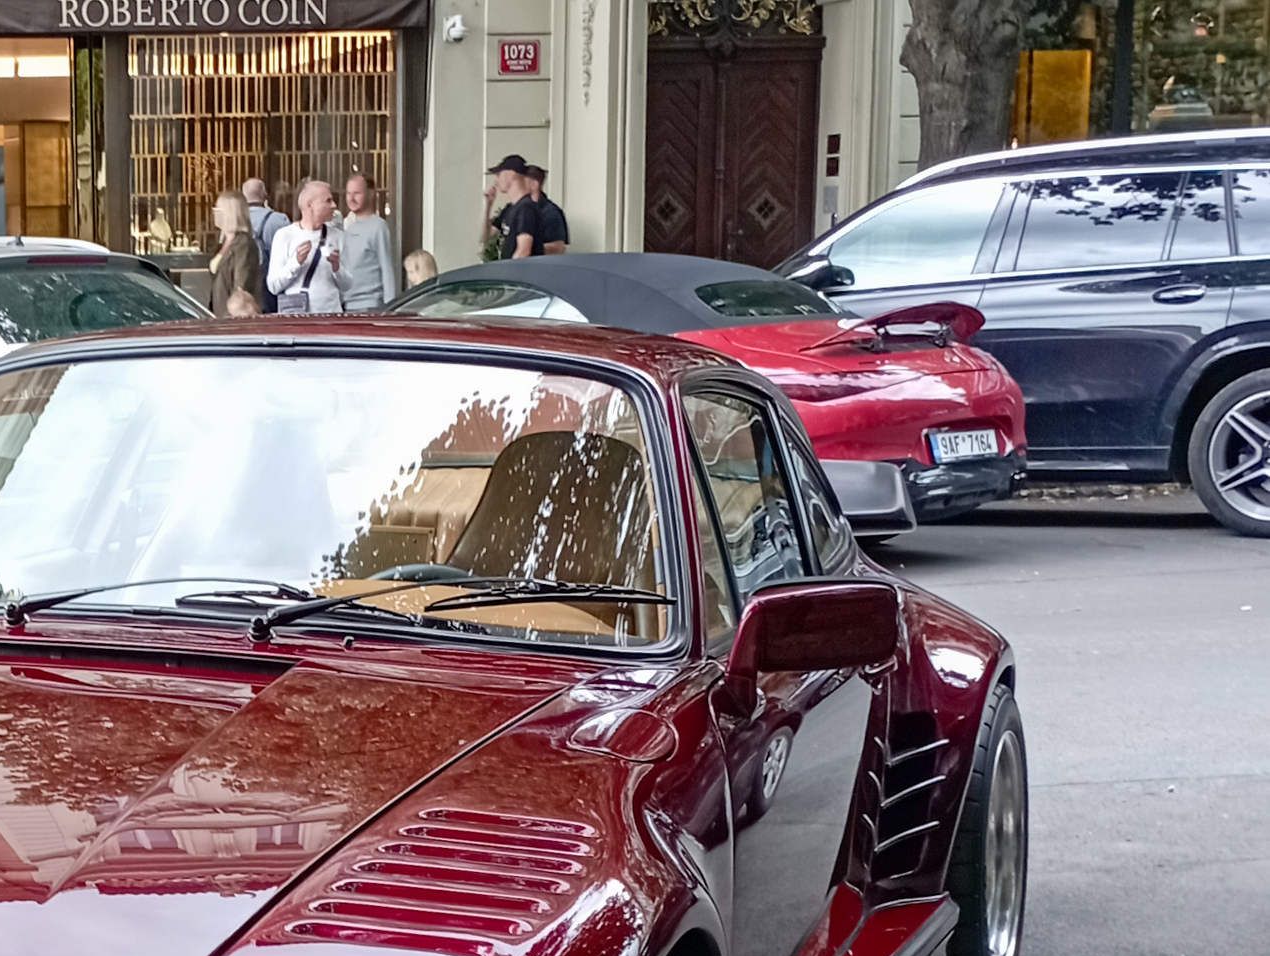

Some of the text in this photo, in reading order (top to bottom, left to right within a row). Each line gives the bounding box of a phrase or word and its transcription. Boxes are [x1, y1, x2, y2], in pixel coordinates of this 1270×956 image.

[59, 0, 328, 27] ROBERTO COIN
[504, 44, 534, 60] 1073
[940, 433, 992, 455] 9AF 7164
